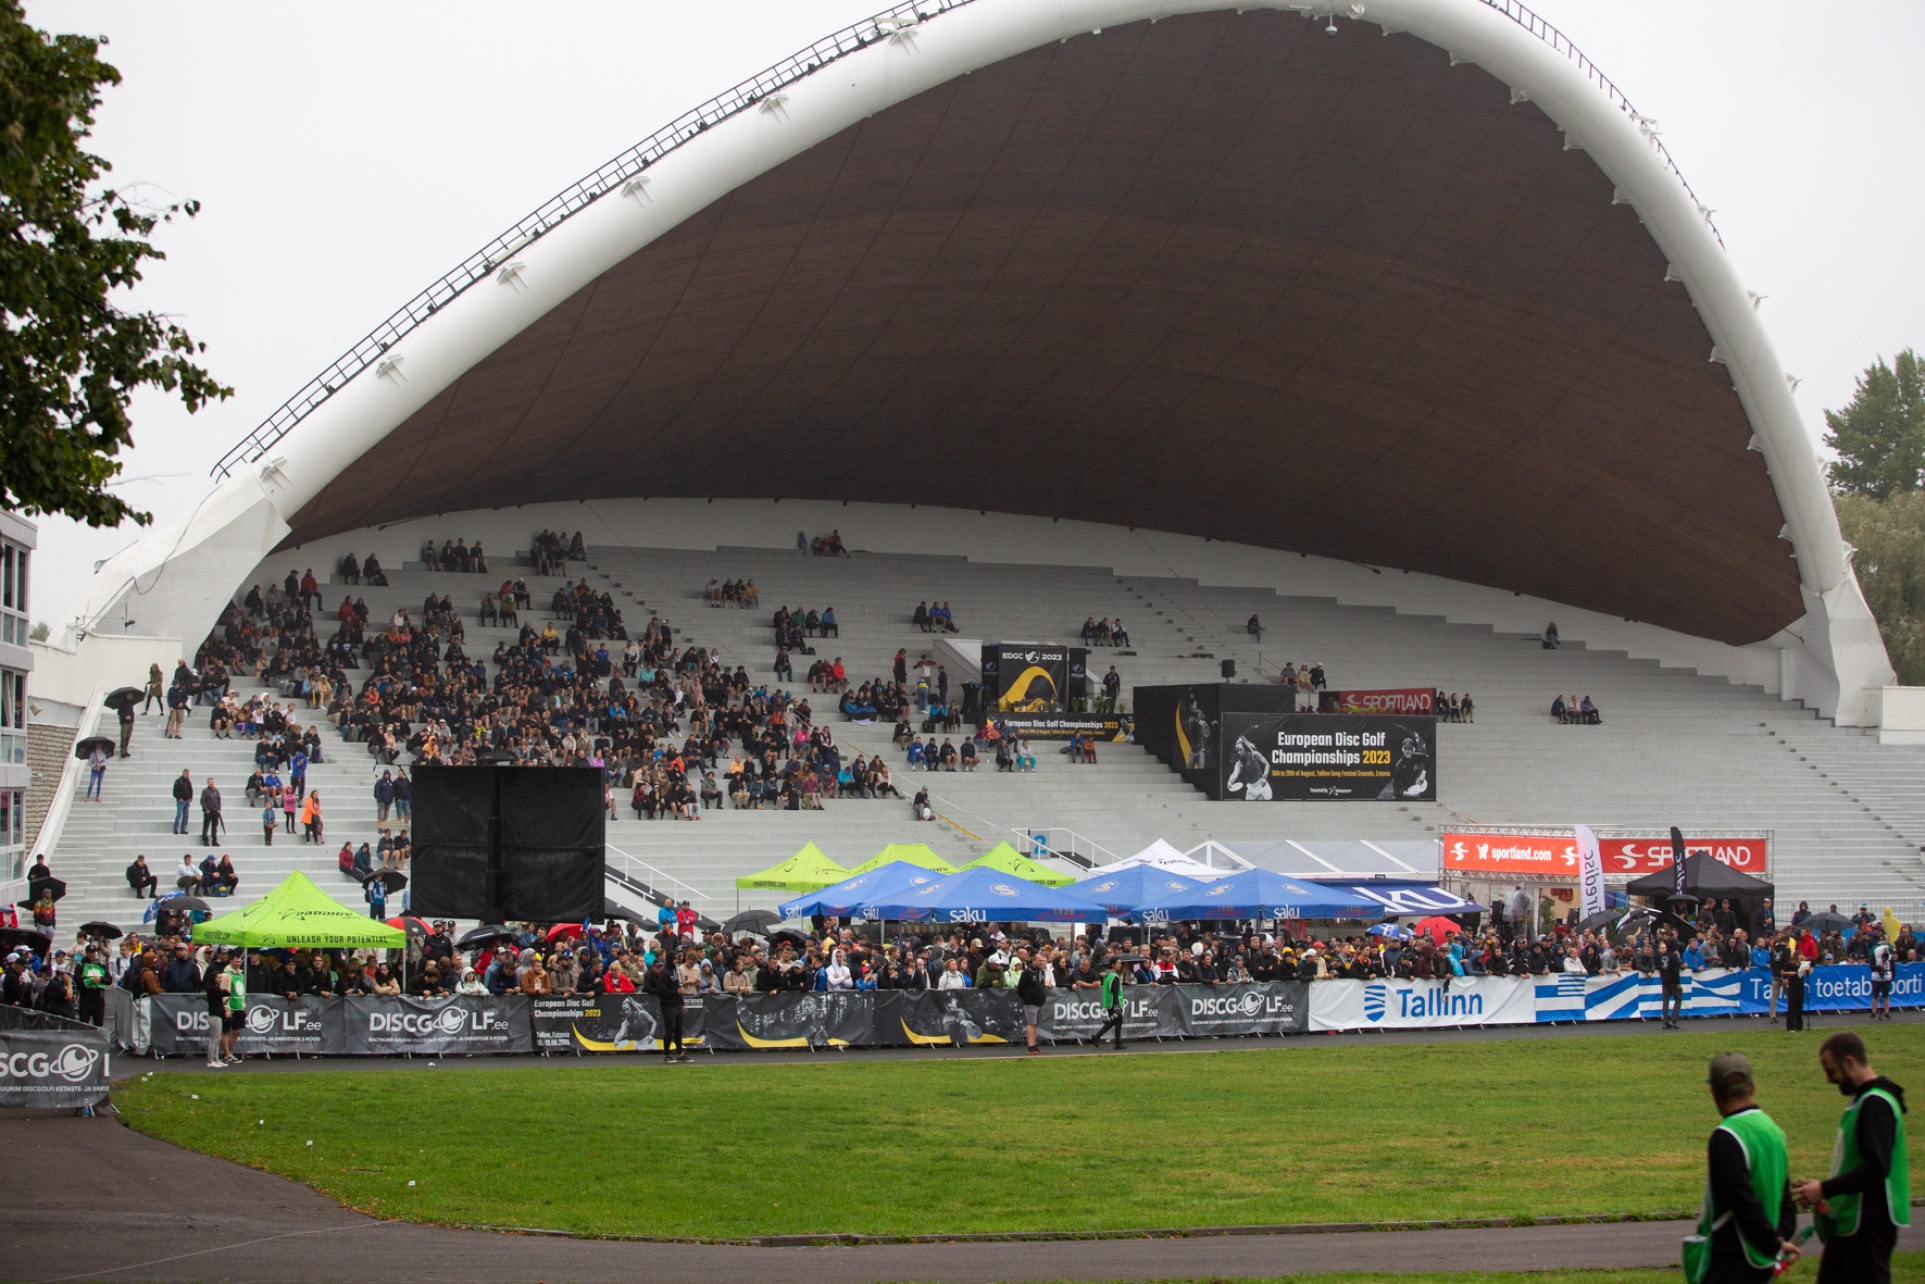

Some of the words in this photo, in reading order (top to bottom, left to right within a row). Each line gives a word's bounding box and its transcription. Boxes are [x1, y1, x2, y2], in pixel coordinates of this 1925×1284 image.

[1002, 652, 1024, 660] EDGC
[1041, 653, 1063, 661] 2023
[1363, 693, 1431, 712] SPORTLAND
[1004, 719, 1032, 729] European
[1033, 719, 1046, 728] Disc
[1047, 720, 1059, 728] Golf
[1060, 720, 1104, 730] Championships
[1278, 731, 1332, 748] European
[1335, 731, 1360, 747] Disc
[1362, 731, 1386, 747] Golf
[1272, 749, 1360, 766] Championships
[1362, 750, 1391, 765] 2023
[1033, 834, 1048, 855] 2
[1491, 841, 1552, 862] sportland.com
[949, 906, 987, 923] saku
[1142, 907, 1169, 923] saku
[1273, 904, 1300, 920] saku
[286, 935, 321, 944] UNLEASH
[324, 935, 343, 944] YOUR
[347, 935, 389, 944] POTENTIAL
[1815, 976, 1872, 998] toetab
[534, 999, 565, 1008] European
[566, 999, 580, 1007] Disc
[581, 998, 595, 1007] Golf
[1396, 987, 1483, 1018] Tallinn
[534, 1009, 584, 1018] Championships
[584, 1009, 601, 1017] 2023
